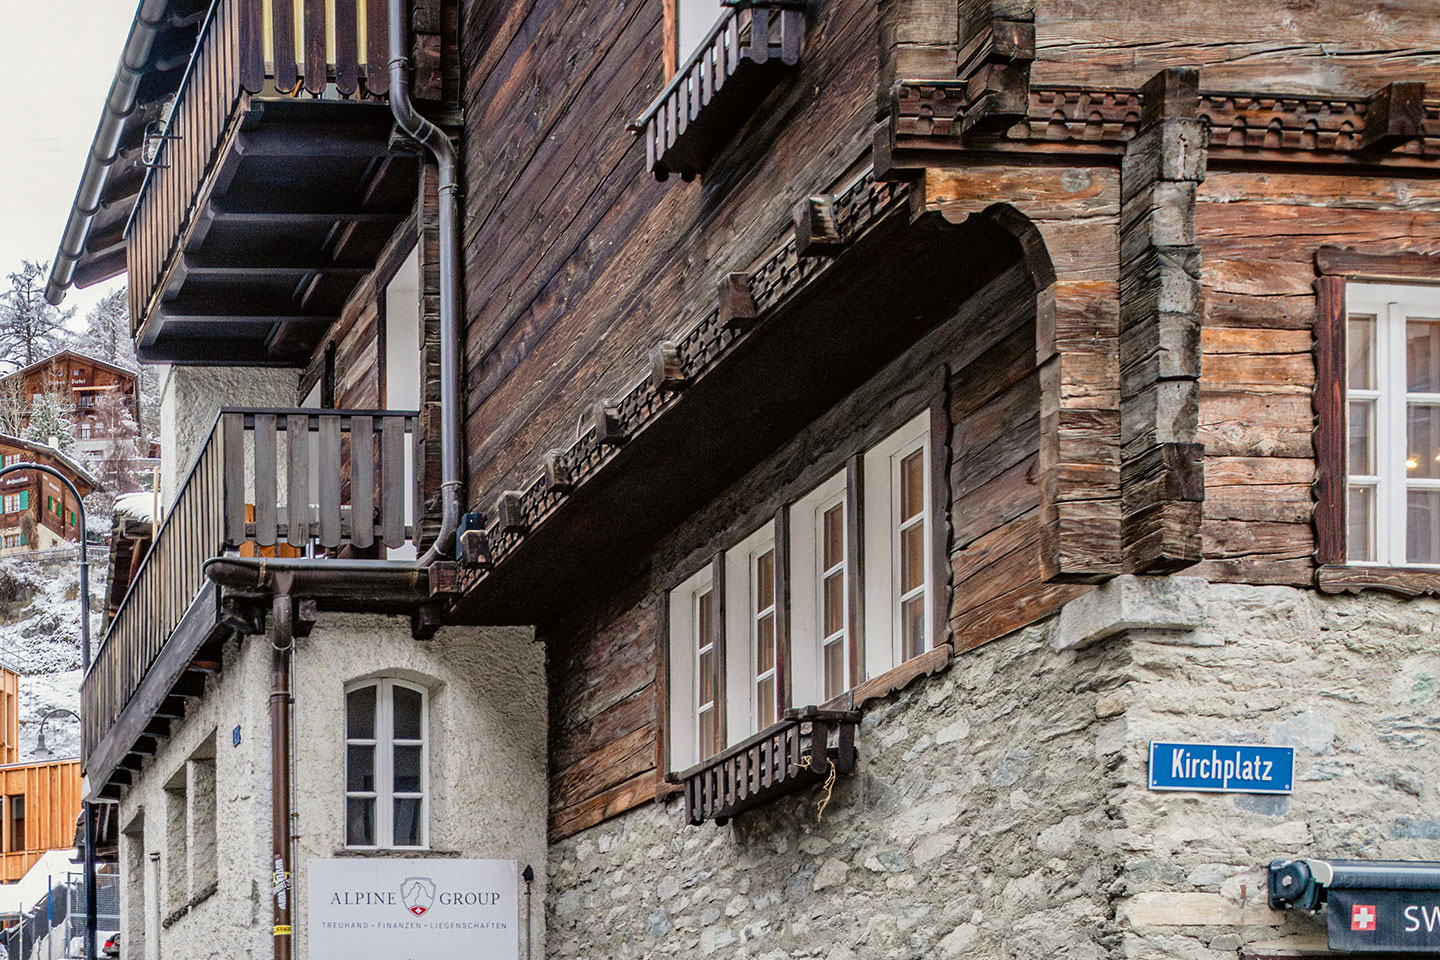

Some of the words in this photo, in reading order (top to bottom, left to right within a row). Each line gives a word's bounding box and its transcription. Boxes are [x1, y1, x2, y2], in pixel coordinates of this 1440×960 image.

[1171, 748, 1273, 789] Kirchplatz
[330, 891, 397, 906] ALPINE
[439, 892, 501, 906] GROUP
[322, 921, 369, 930] TREUHAND
[377, 921, 422, 930] FINANZEN
[430, 922, 507, 930] LIEGENSCHAFTEN
